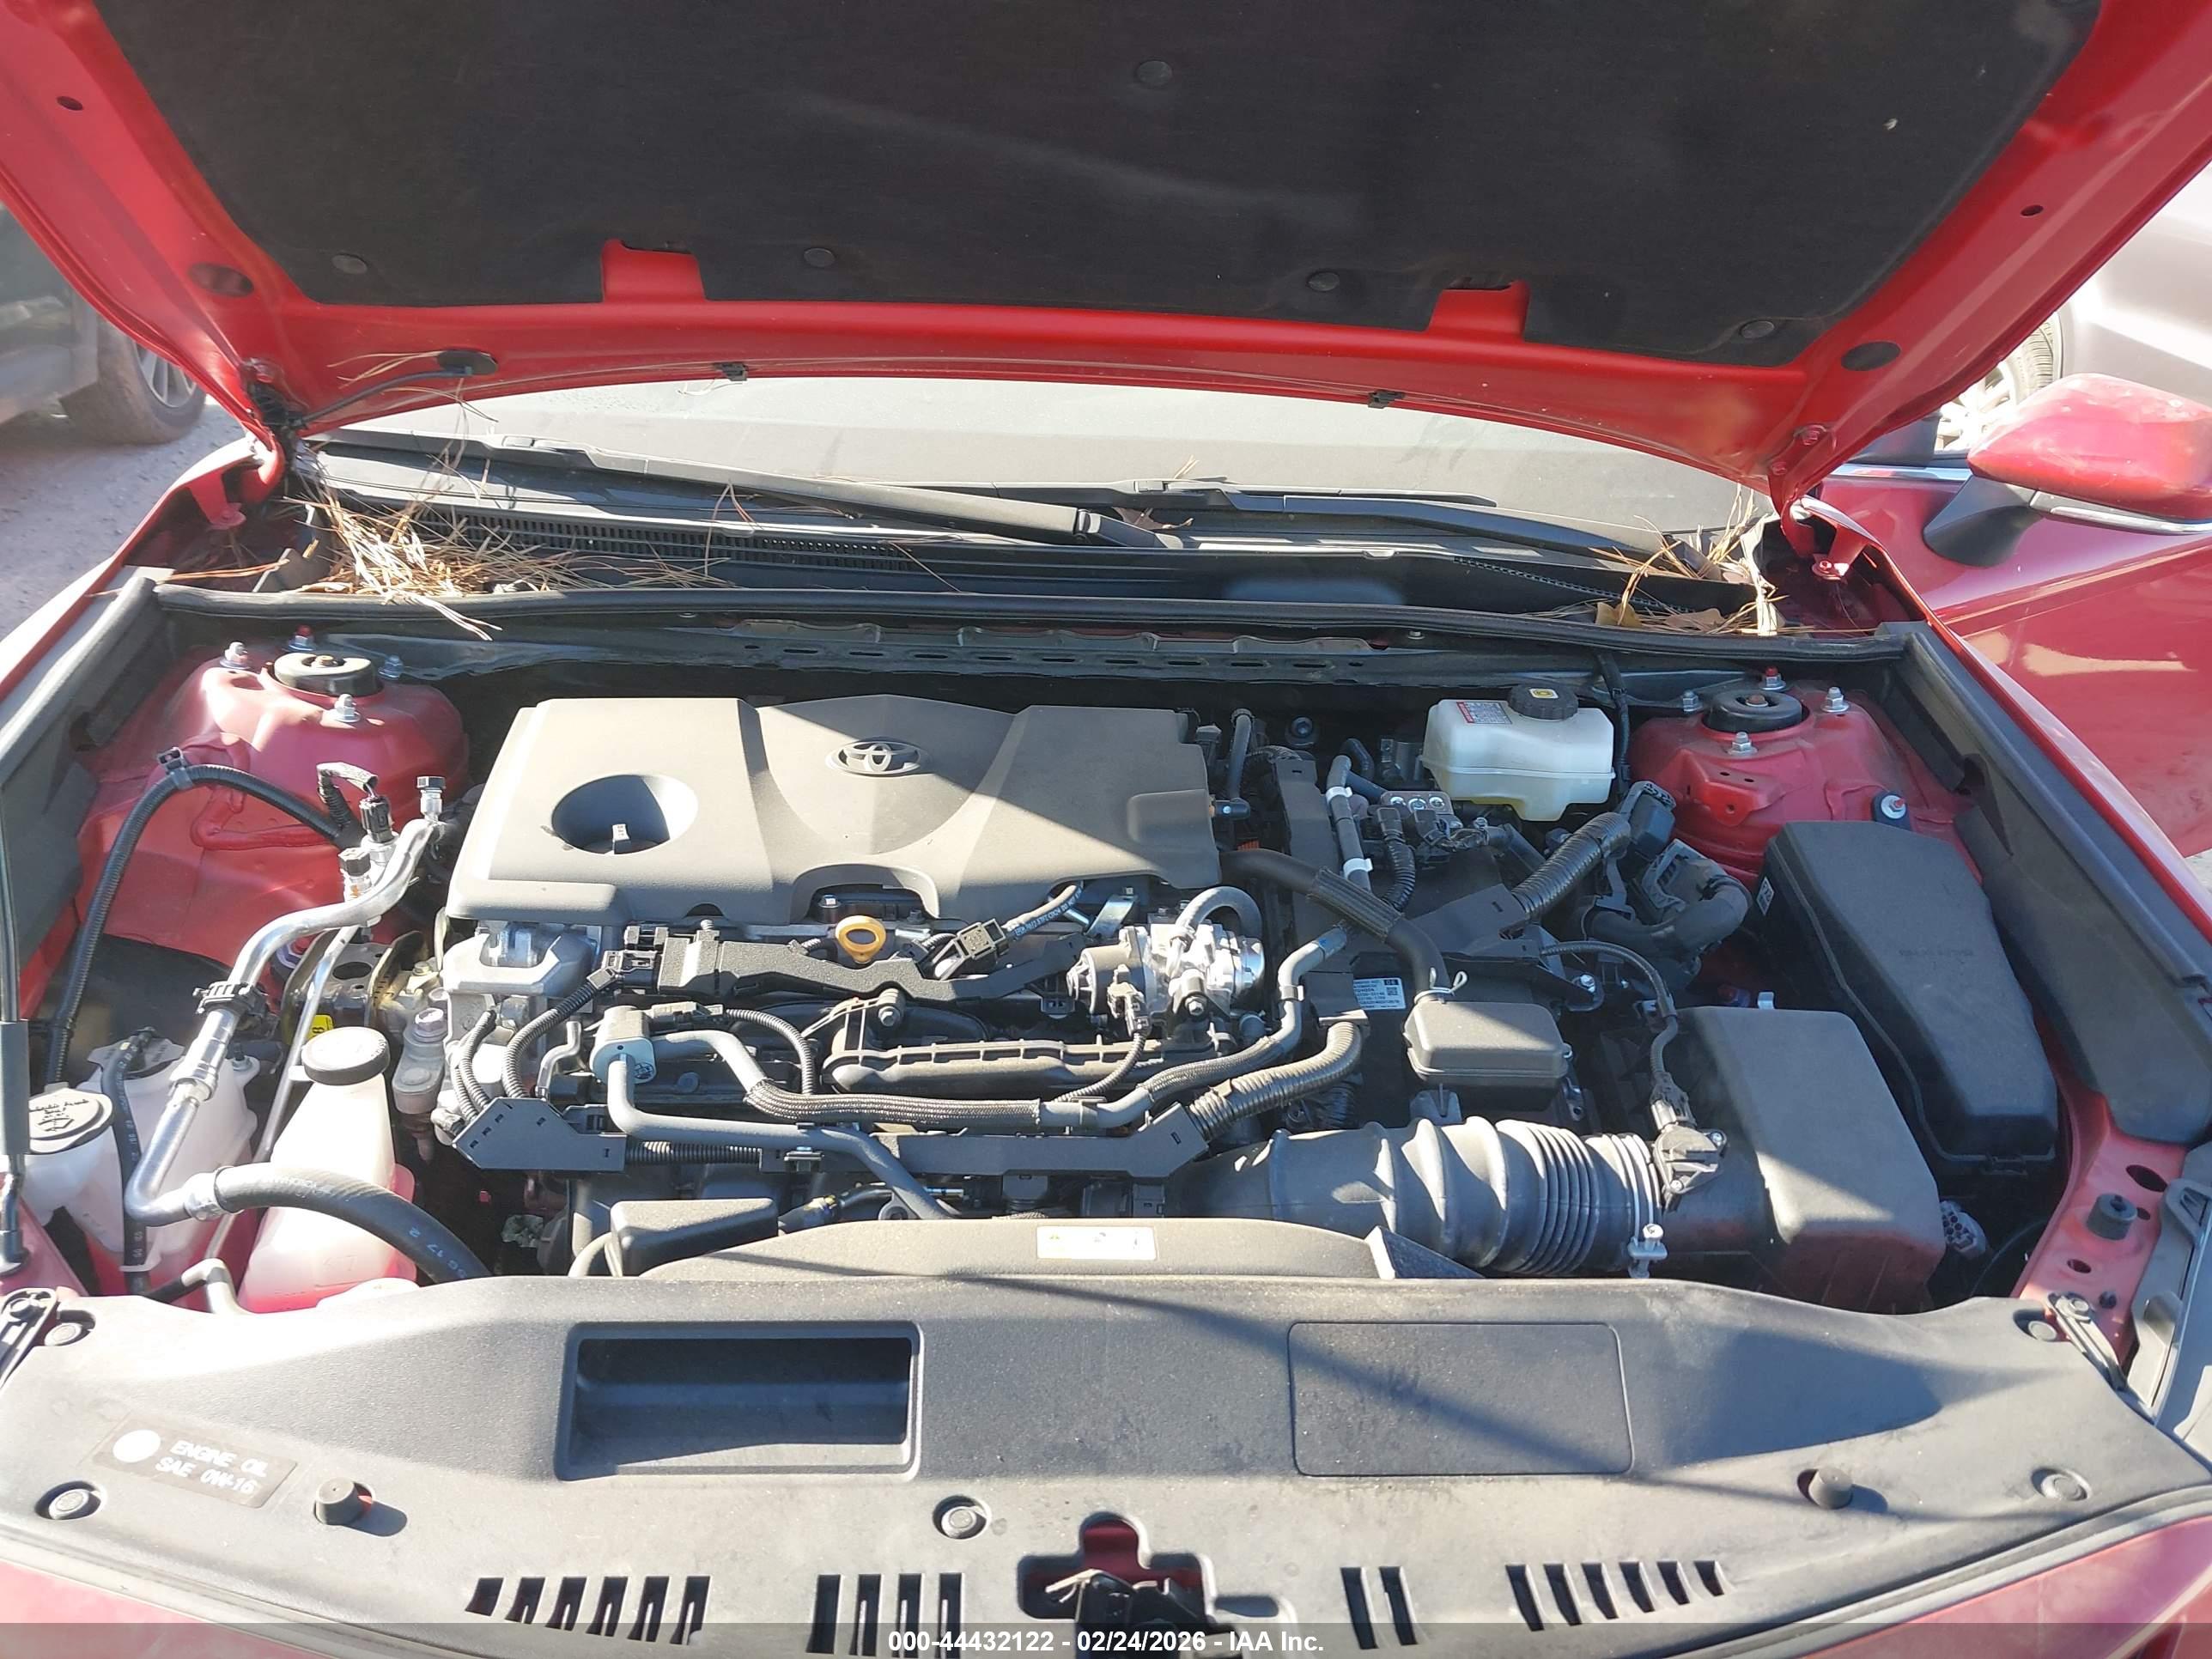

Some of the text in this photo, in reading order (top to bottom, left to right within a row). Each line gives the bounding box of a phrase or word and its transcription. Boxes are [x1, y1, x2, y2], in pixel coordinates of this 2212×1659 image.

[155, 1457, 259, 1494] SAE 0W-16
[170, 1440, 269, 1477] ENGINE OIL
